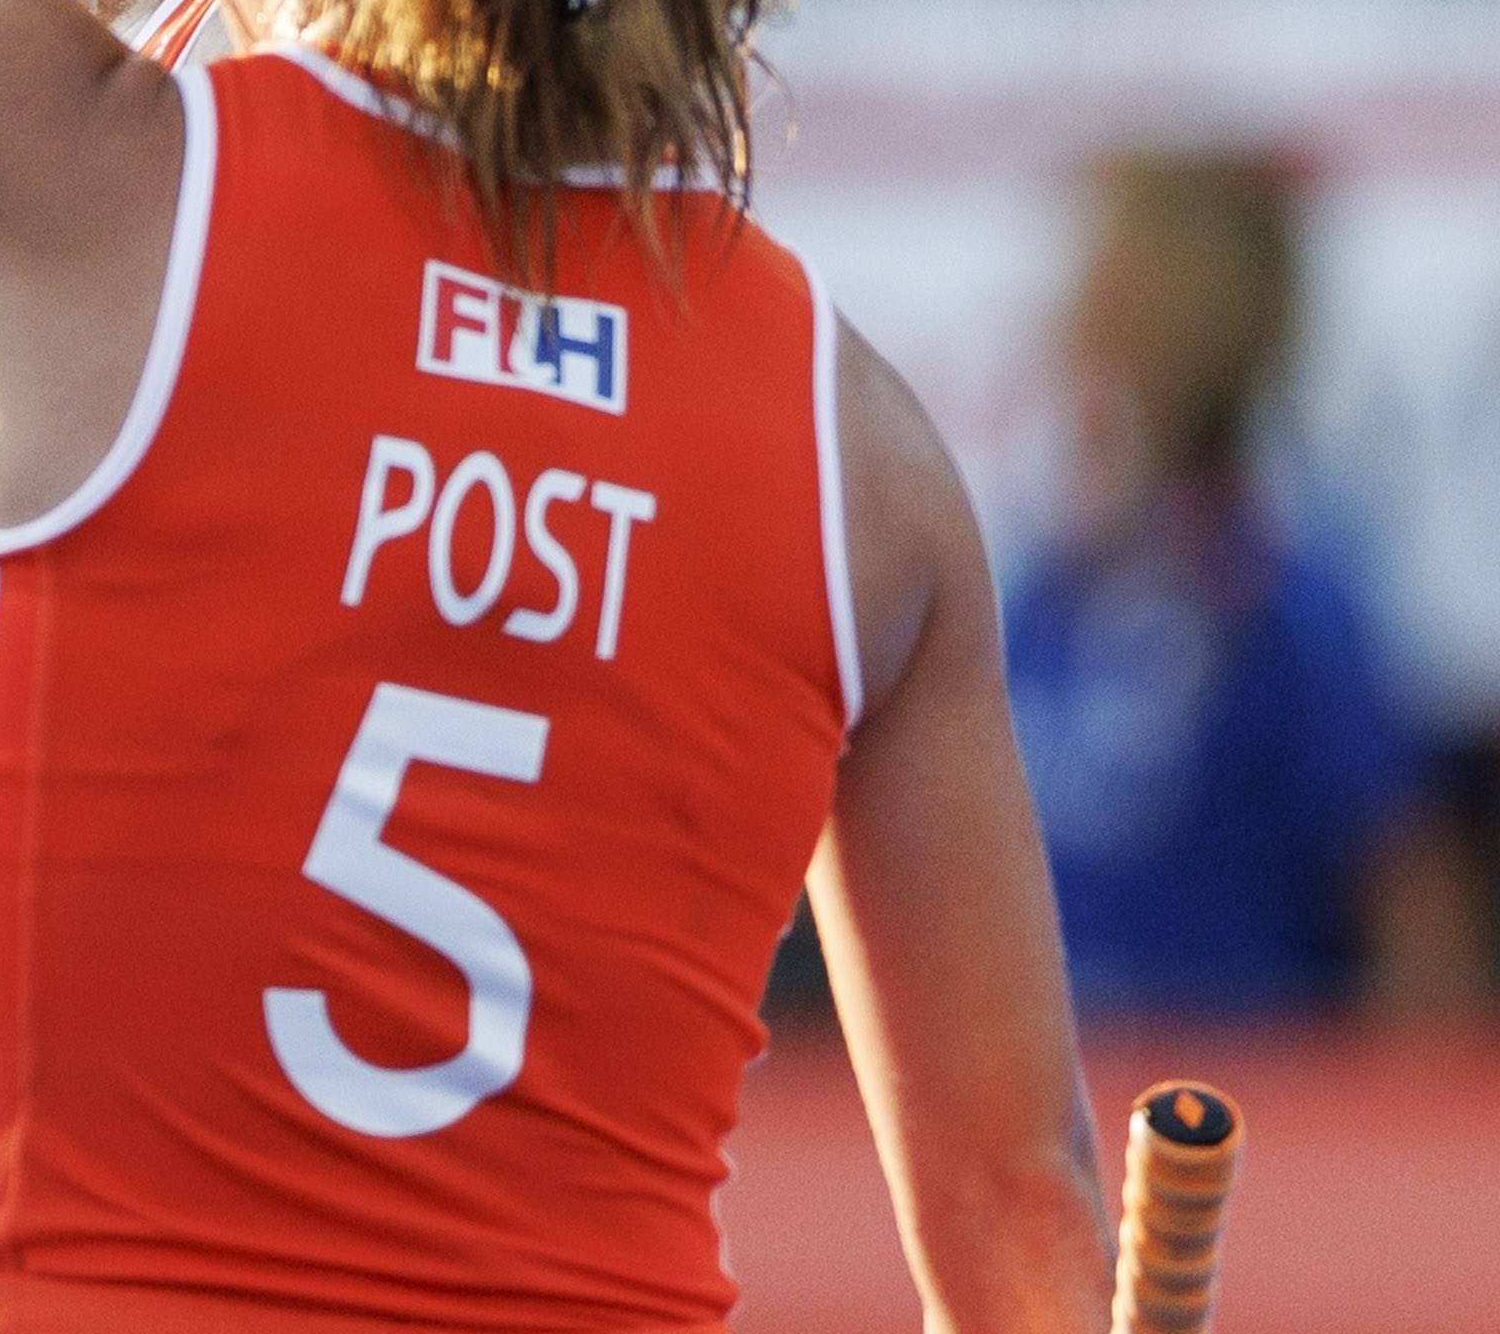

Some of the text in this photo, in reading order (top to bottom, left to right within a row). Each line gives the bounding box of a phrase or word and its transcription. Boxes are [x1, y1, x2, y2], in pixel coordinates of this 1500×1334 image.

[430, 275, 615, 399] FIH
[339, 433, 657, 661] POST
[262, 681, 551, 1139] 5
